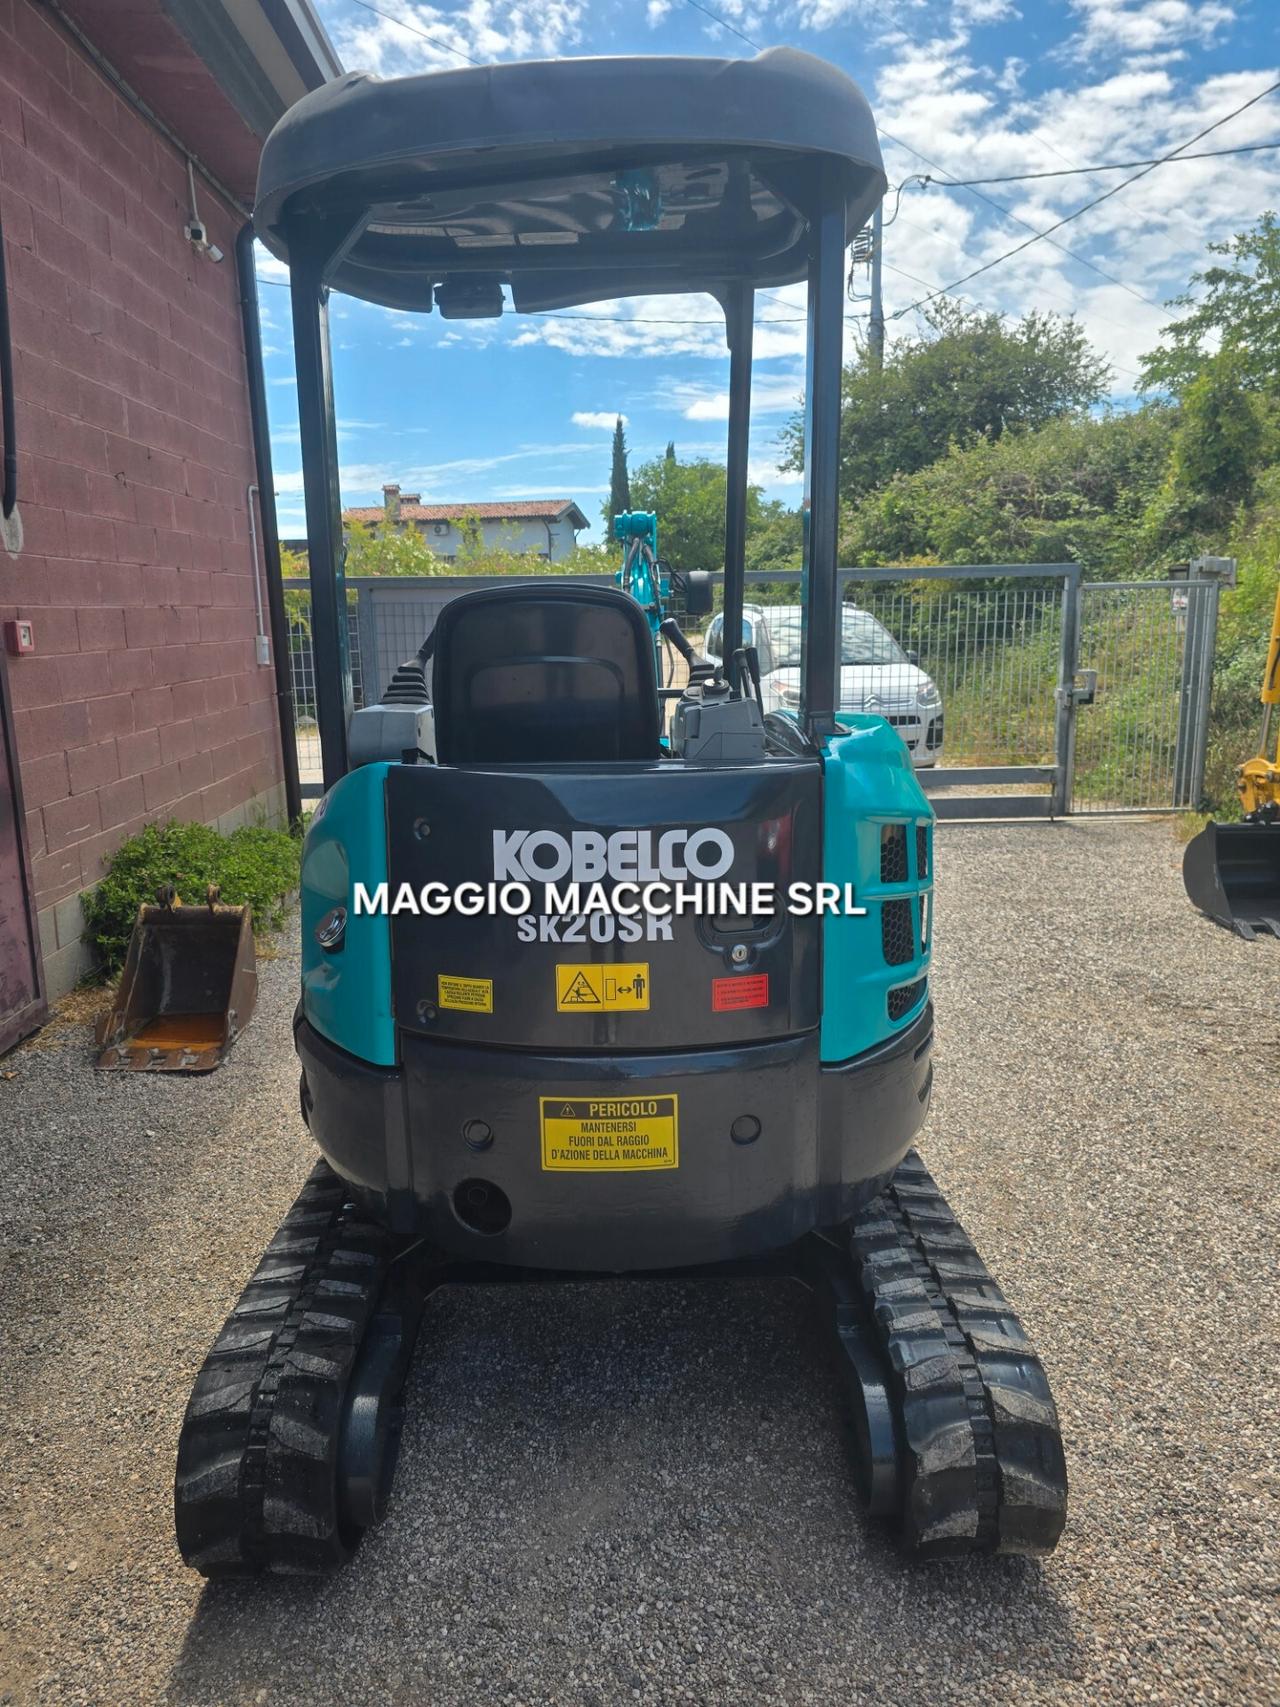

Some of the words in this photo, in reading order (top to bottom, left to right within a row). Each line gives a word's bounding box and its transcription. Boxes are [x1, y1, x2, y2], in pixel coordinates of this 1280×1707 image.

[493, 828, 734, 883] KOBELCO
[517, 910, 674, 943] SK20SR
[589, 1101, 658, 1117] PERICOLO
[581, 1121, 637, 1133] MANTENERSI
[569, 1136, 595, 1147] FUORI
[597, 1135, 614, 1147] DAL
[616, 1134, 650, 1146] RAGGIO
[551, 1149, 591, 1160] D'AZIONE
[592, 1149, 620, 1160] DELLA
[622, 1147, 668, 1159] MACCHINA
